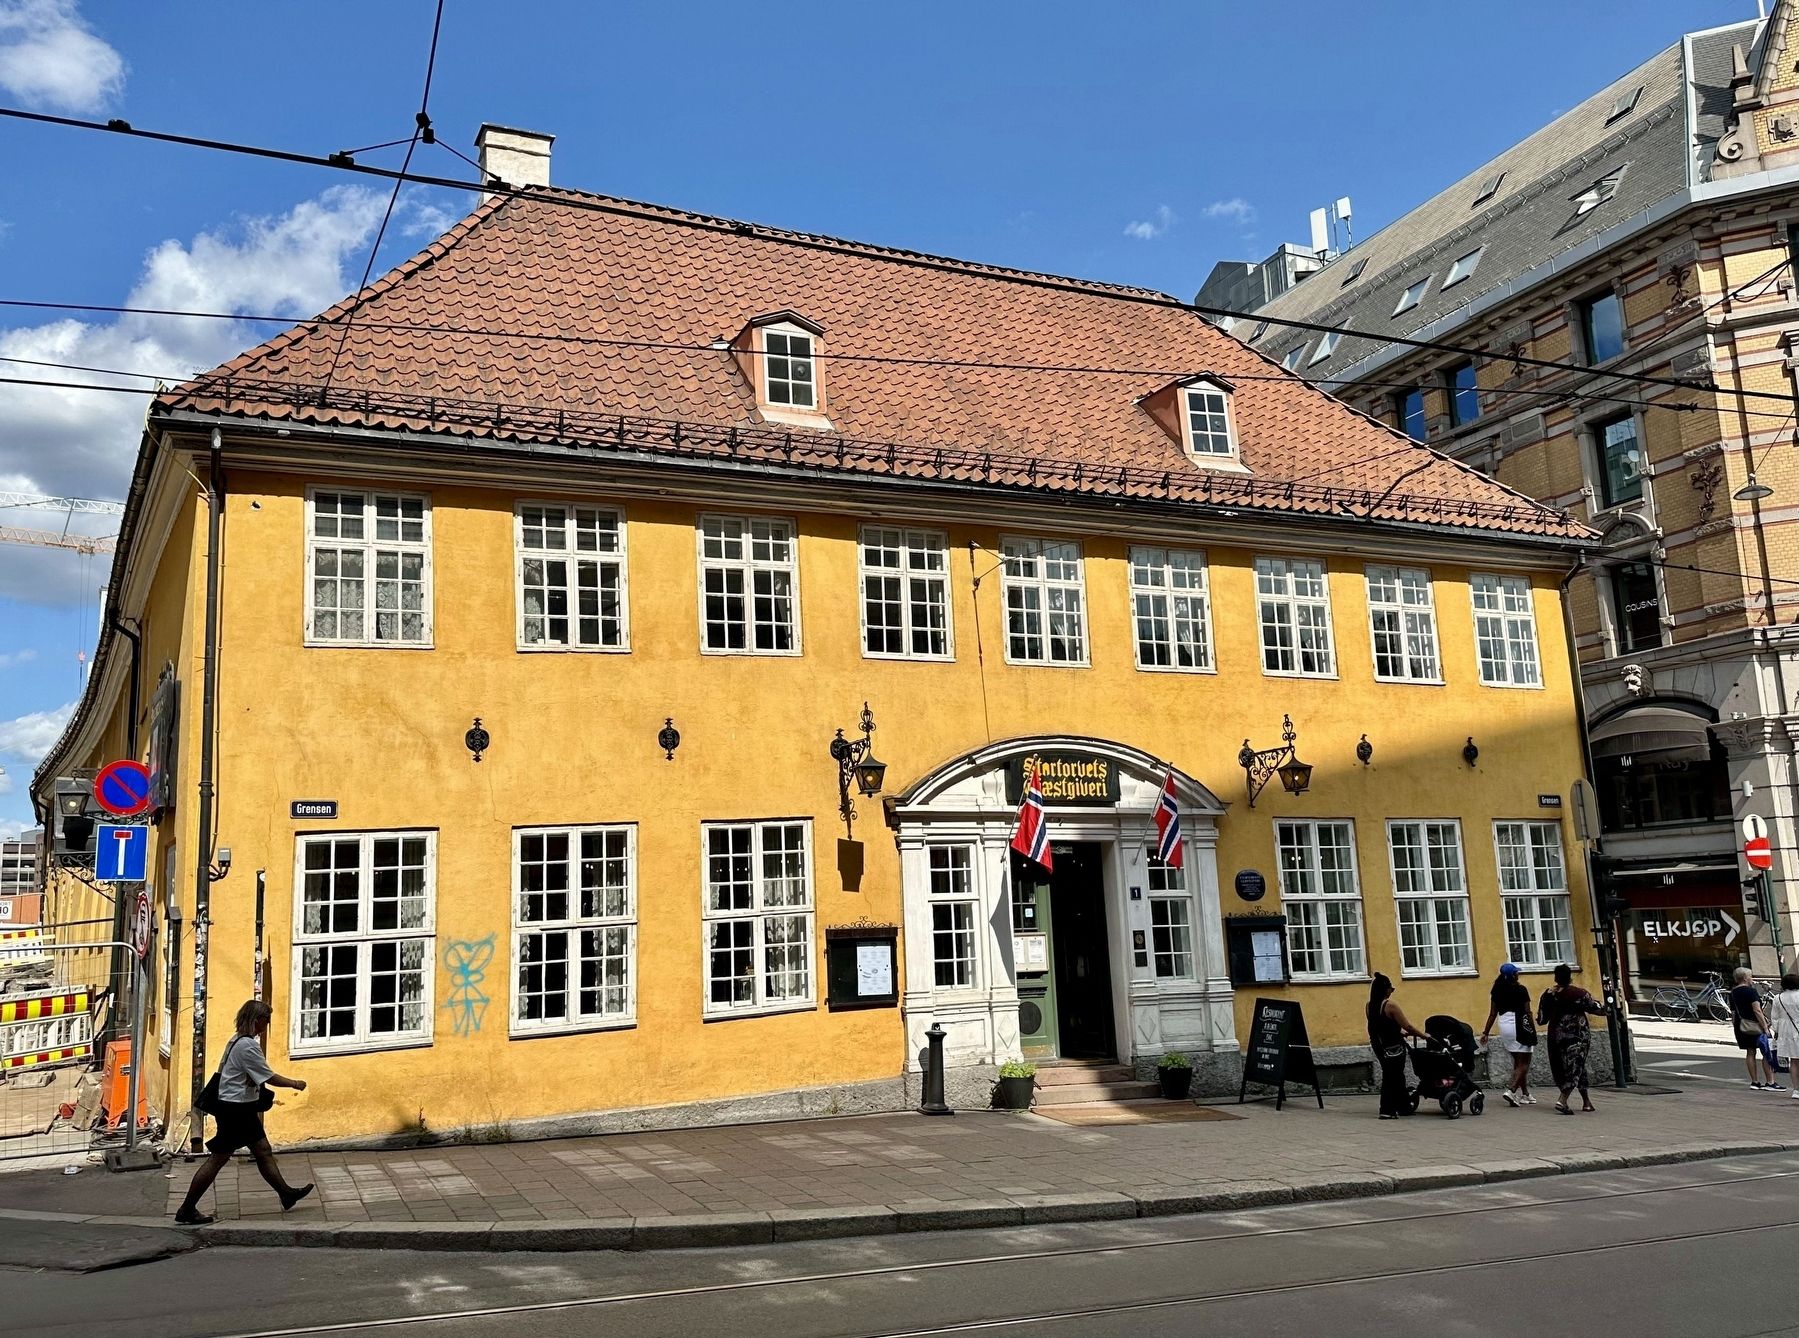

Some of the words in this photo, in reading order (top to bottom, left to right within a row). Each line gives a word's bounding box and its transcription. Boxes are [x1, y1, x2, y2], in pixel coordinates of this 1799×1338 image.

[1625, 598, 1658, 612] COUSINS
[1023, 778, 1108, 800] æstgiveri
[296, 803, 332, 814] Grensen
[1134, 888, 1139, 898] 1
[1643, 920, 1722, 938] ELKJØP
